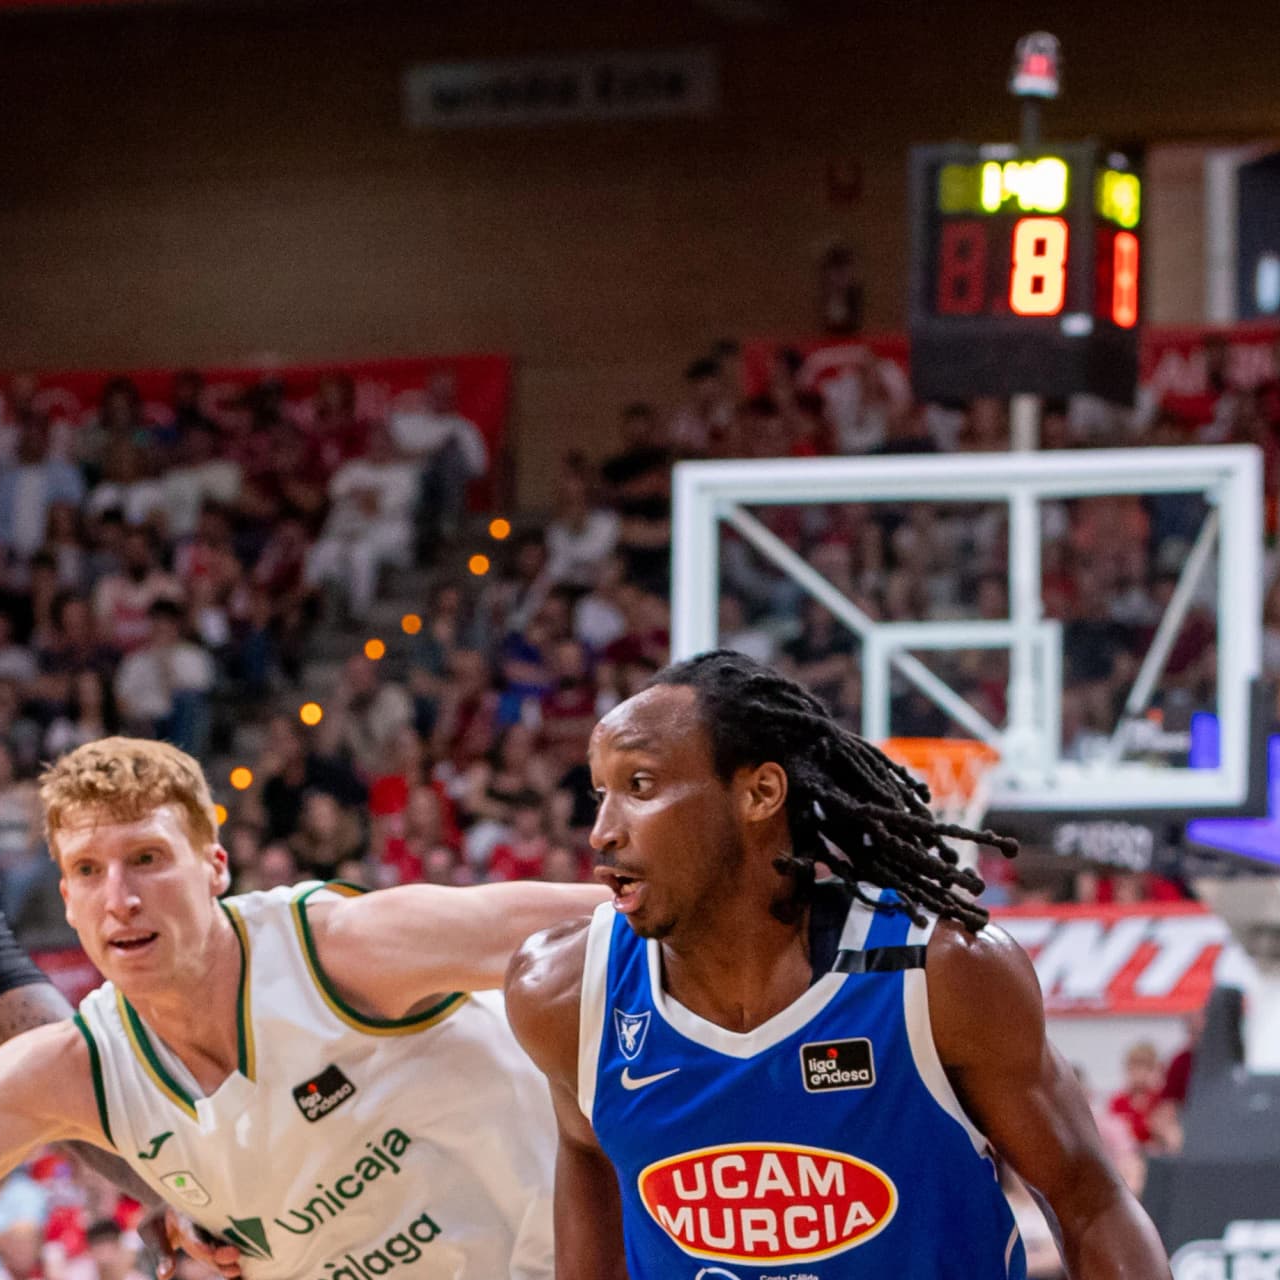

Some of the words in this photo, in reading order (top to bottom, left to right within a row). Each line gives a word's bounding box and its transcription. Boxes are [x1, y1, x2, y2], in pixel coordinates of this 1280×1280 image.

[808, 1057, 837, 1073] liga
[810, 1069, 870, 1086] endesa
[274, 1126, 413, 1237] Unicaja
[671, 1152, 847, 1201] UCAM
[655, 1199, 877, 1253] MURCIA
